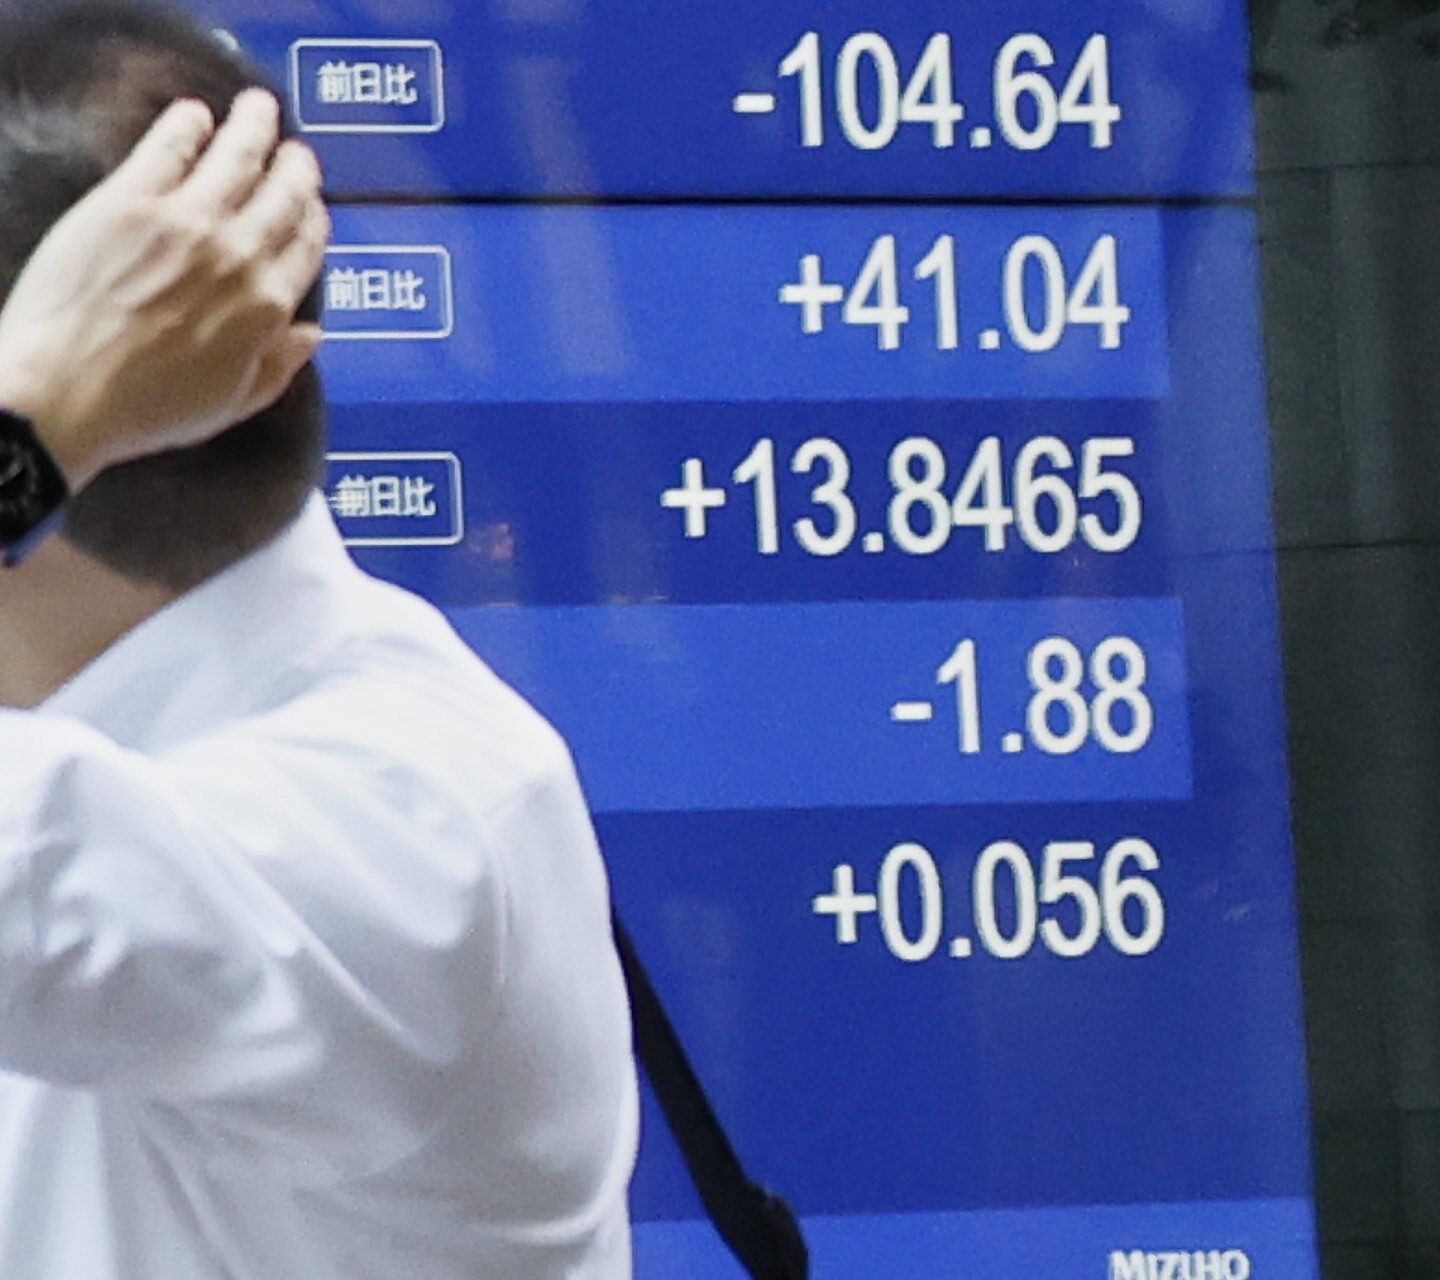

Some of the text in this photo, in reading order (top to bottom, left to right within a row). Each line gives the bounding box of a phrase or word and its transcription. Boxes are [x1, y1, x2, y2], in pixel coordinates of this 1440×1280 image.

[318, 61, 417, 105] 前日比
[733, 31, 1122, 151] -104.64
[328, 268, 426, 310] 前日比
[779, 234, 1131, 352] +41.04
[332, 476, 436, 517] 前日比
[661, 435, 1141, 556] +13.8465
[891, 636, 1153, 755] -1.88
[814, 837, 1165, 962] +0.056
